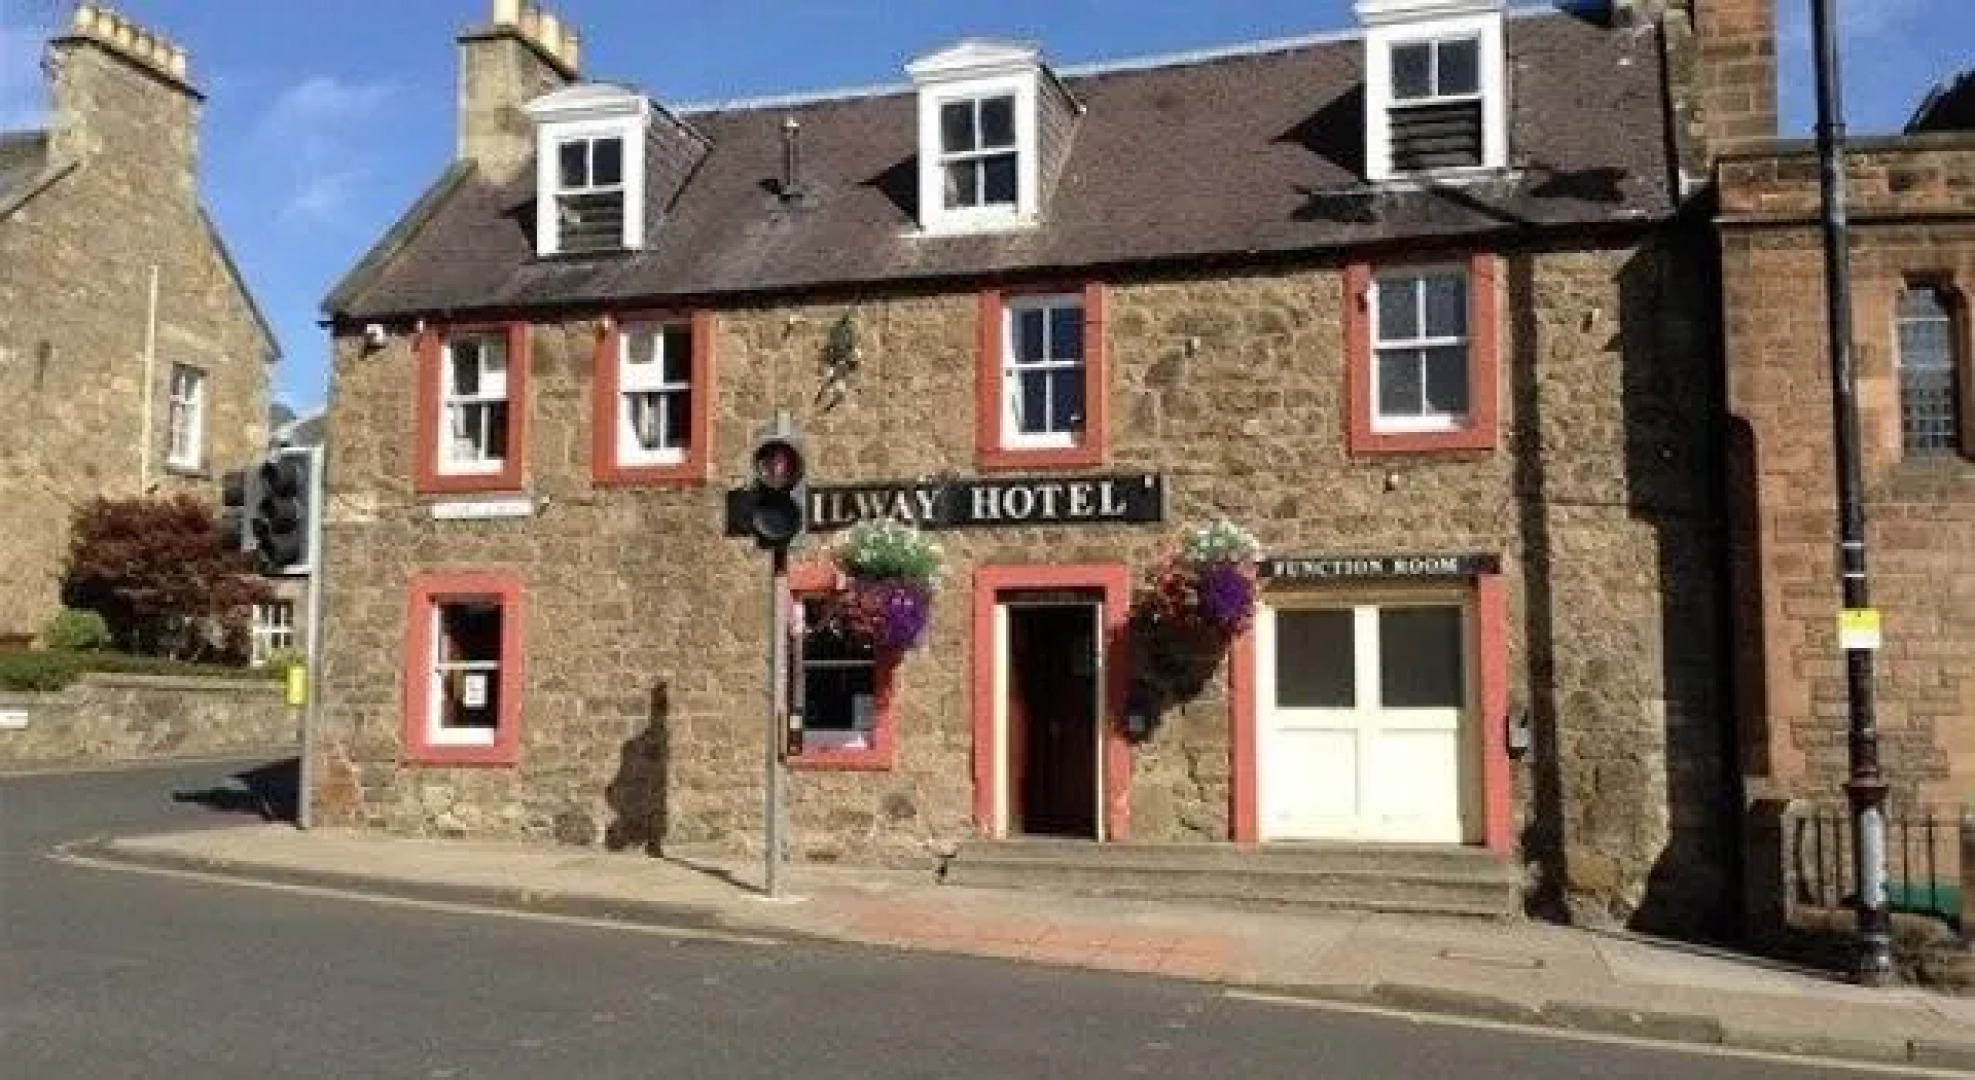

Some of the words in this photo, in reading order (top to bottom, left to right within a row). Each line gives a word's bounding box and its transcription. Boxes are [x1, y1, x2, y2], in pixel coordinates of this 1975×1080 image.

[810, 488, 942, 524] ILWAY
[971, 480, 1127, 520] HOTEL
[1273, 559, 1384, 576] FUNCTION
[1393, 557, 1458, 575] ROOM
